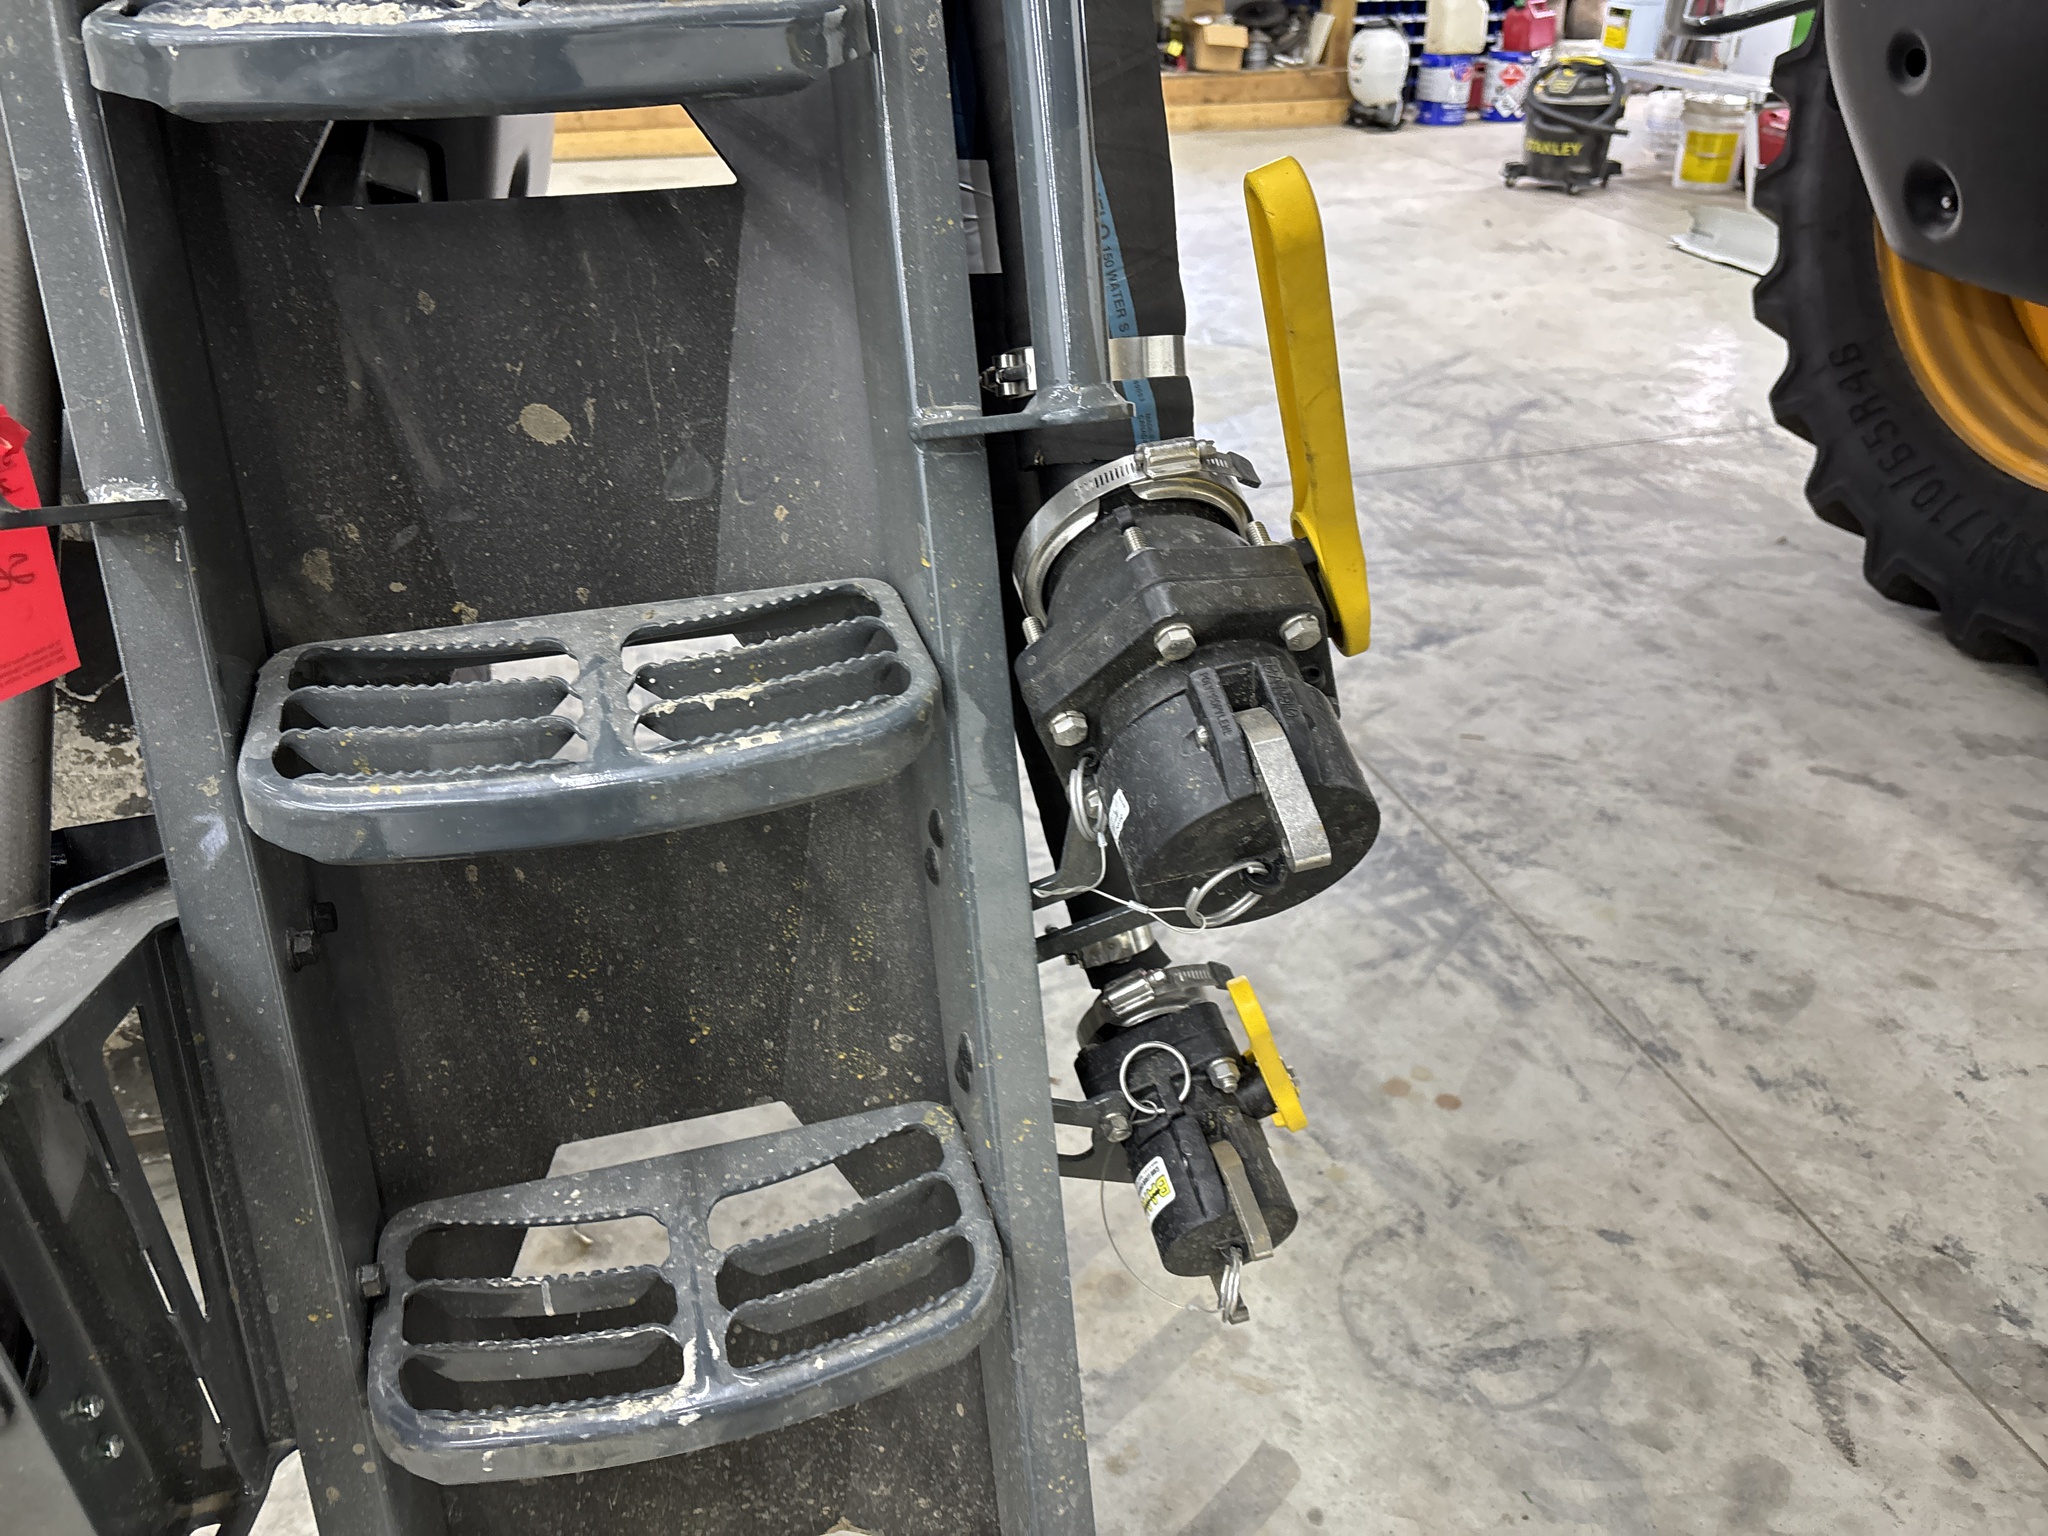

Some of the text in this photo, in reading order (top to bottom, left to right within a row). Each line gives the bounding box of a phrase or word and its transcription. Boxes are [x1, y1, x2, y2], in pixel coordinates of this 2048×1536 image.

[1102, 245, 1114, 268] 150
[1106, 267, 1127, 319] WATER
[1829, 342, 1985, 548] 710/65R46
